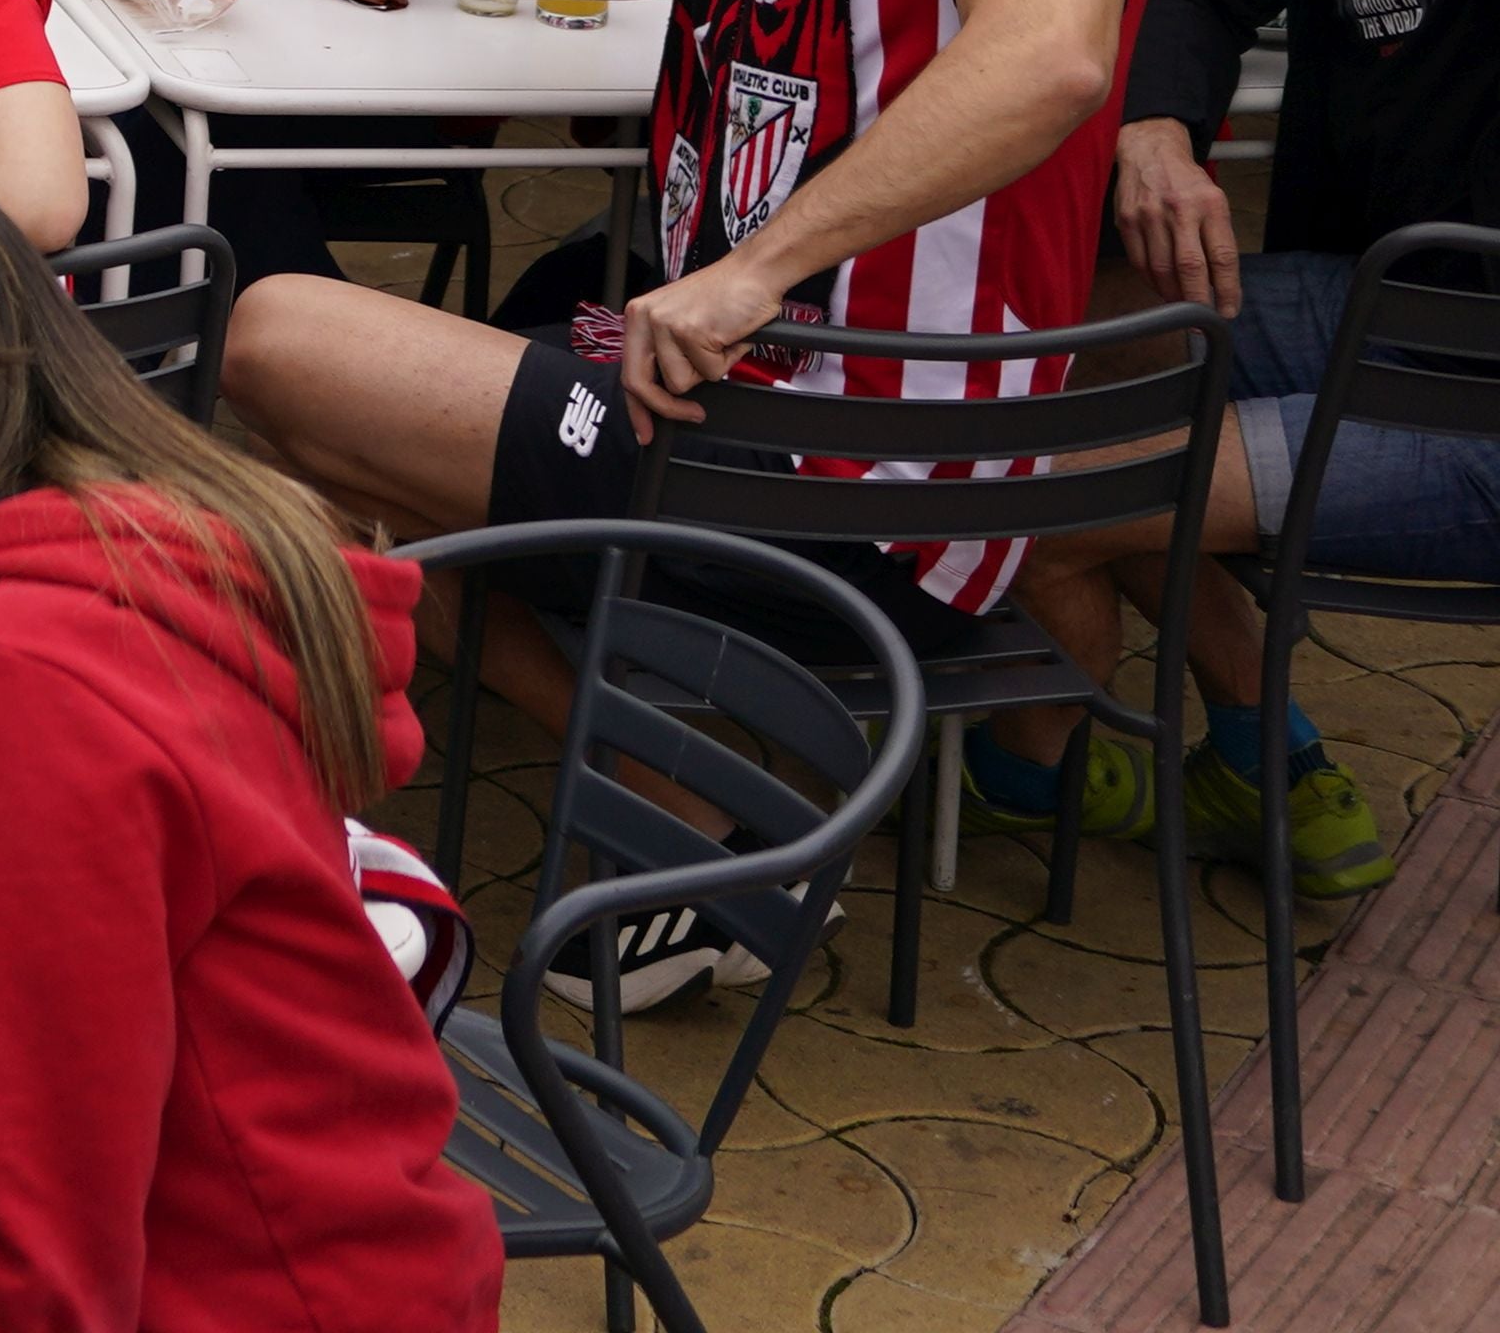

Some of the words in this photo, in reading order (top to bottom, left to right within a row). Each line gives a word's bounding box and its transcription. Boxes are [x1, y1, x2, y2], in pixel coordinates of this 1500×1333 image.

[1358, 15, 1385, 39] THE
[1381, 8, 1424, 36] WORLD
[772, 79, 810, 101] CLUB
